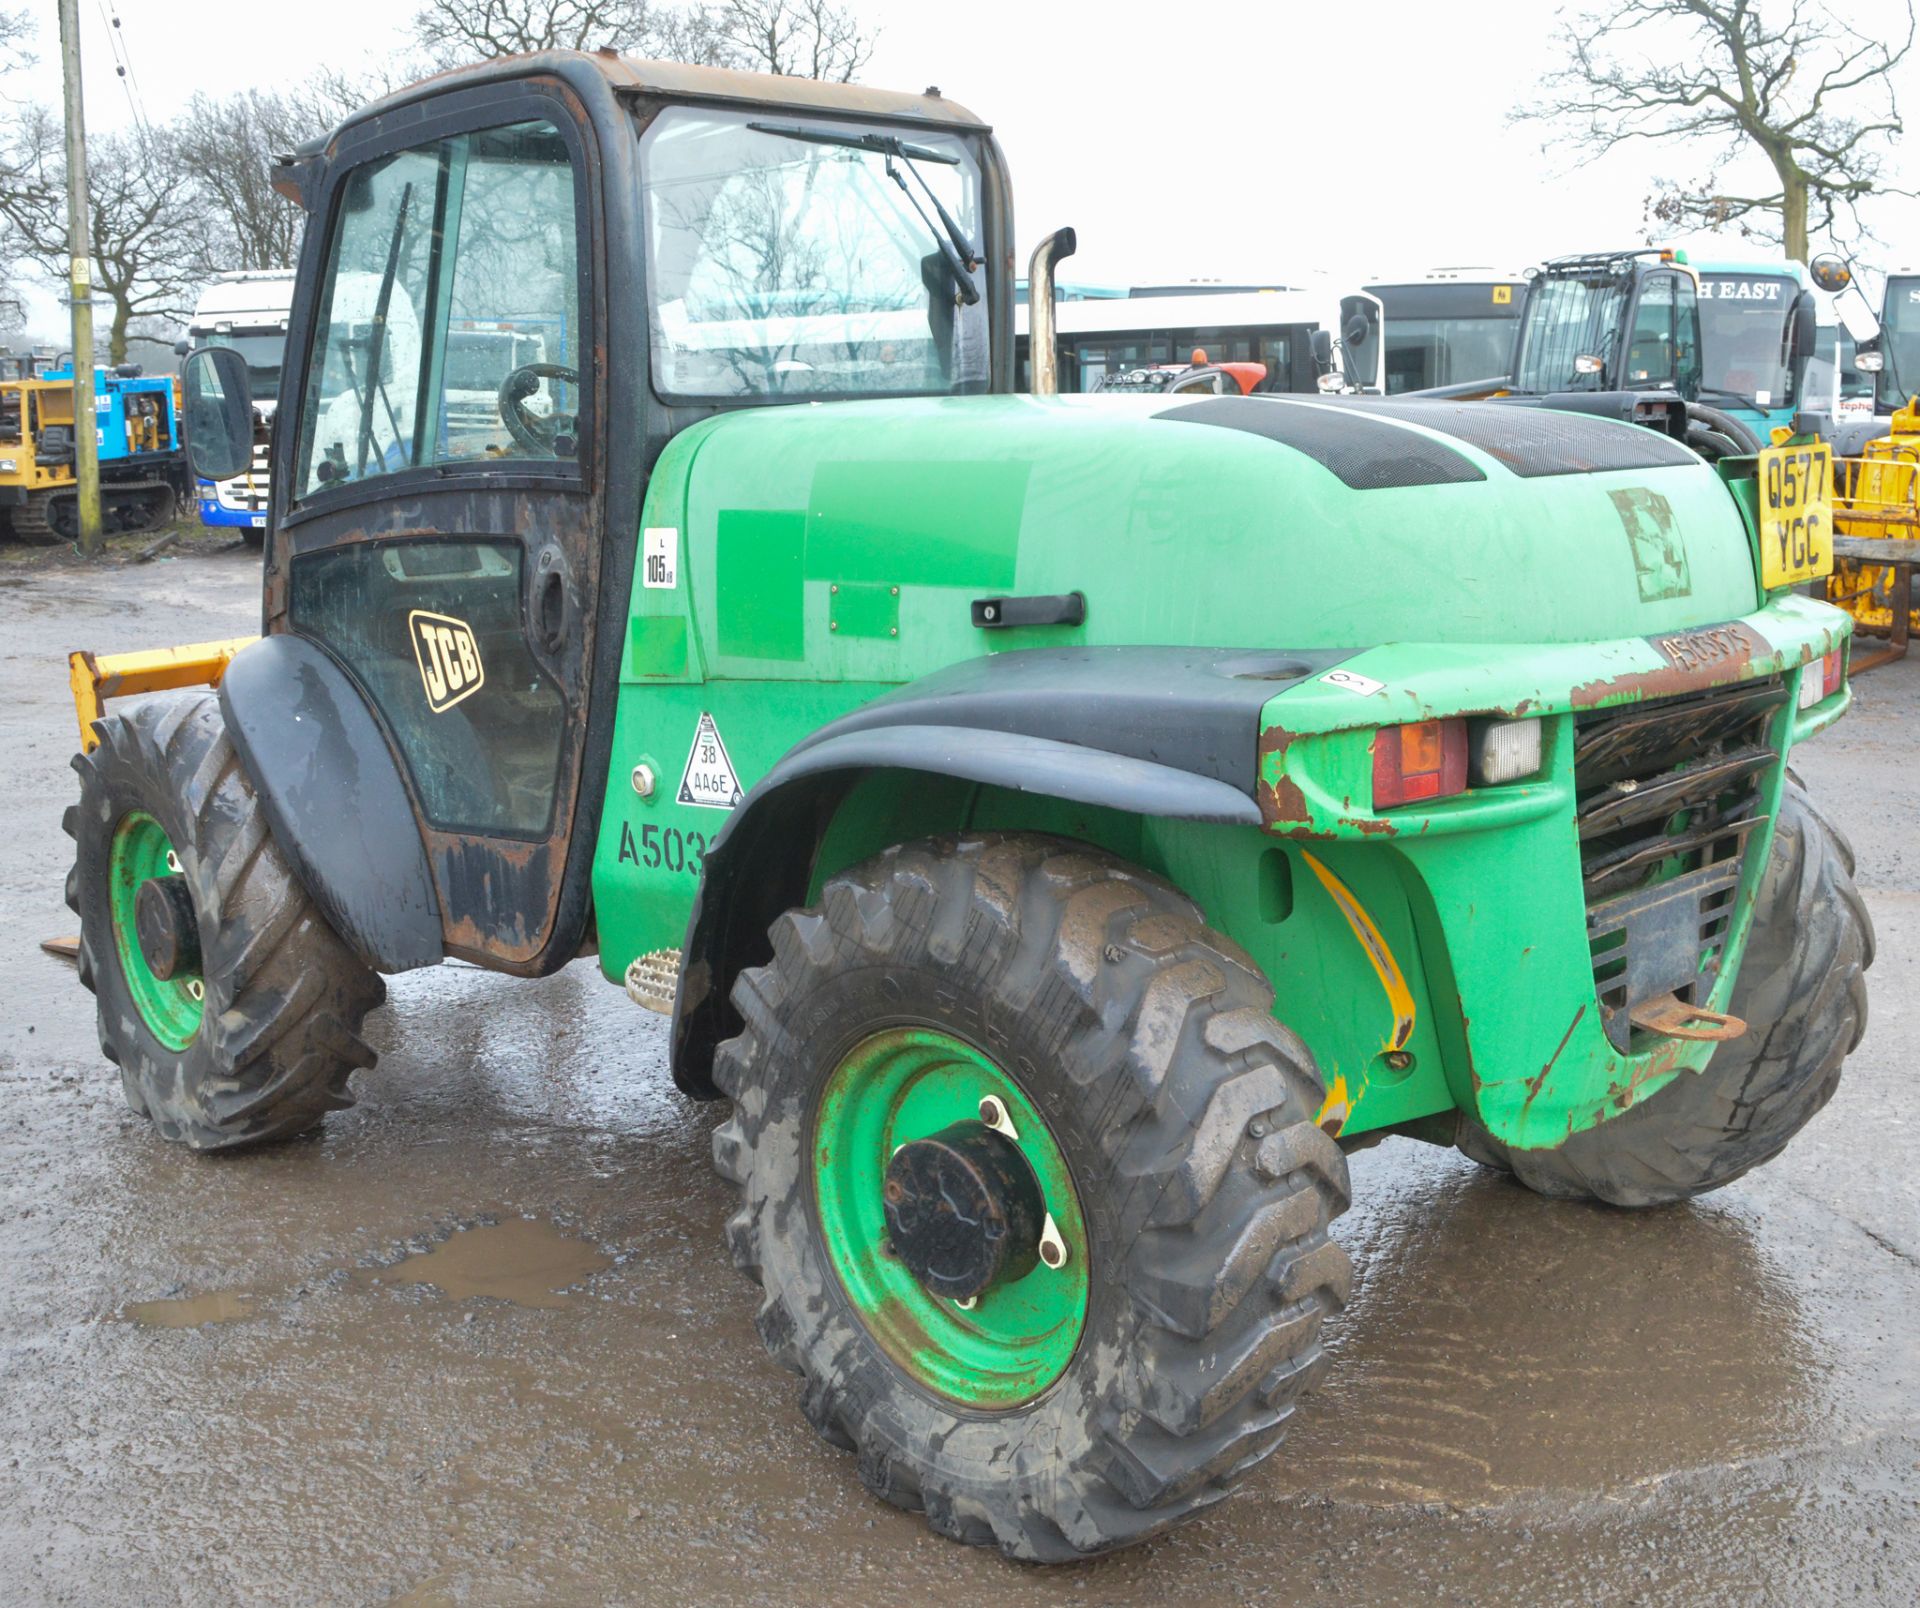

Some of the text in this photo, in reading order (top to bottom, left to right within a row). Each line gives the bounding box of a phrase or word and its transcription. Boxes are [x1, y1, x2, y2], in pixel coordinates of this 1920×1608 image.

[1718, 282, 1780, 299] EAST
[1768, 451, 1826, 509] Q577
[660, 538, 665, 548] L
[1777, 514, 1819, 572] YGC
[419, 622, 478, 701] JCB
[701, 745, 717, 764] 38
[694, 772, 728, 794] AA6E
[618, 820, 716, 877] A503
